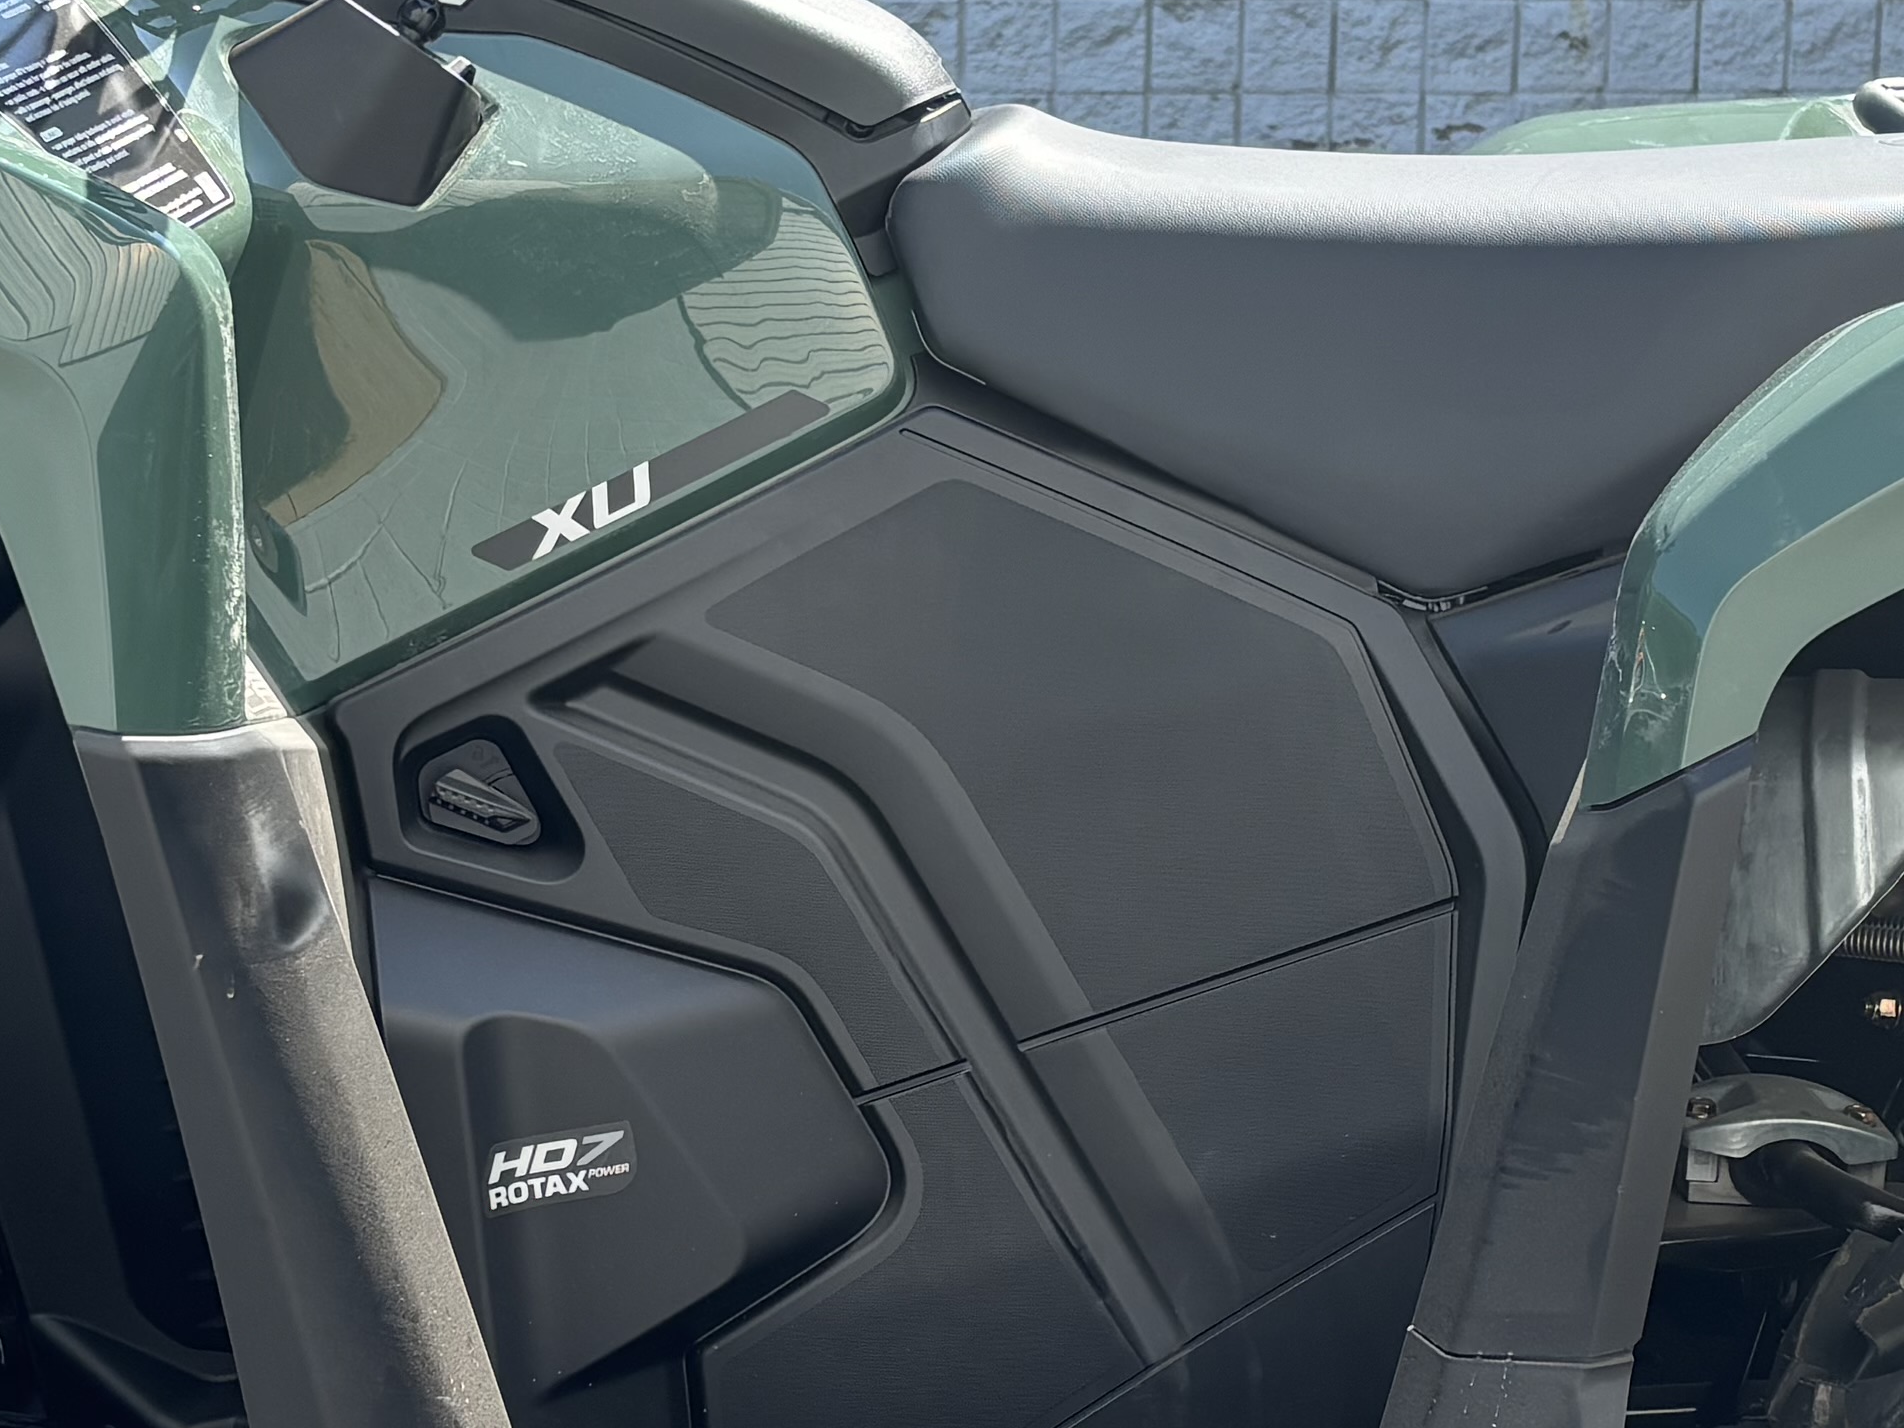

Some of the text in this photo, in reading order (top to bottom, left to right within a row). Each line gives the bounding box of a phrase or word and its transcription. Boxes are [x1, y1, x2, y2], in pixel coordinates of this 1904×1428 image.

[532, 461, 651, 560] XU
[488, 1129, 625, 1185] HD7
[488, 1162, 630, 1211] ROTAX POWER
